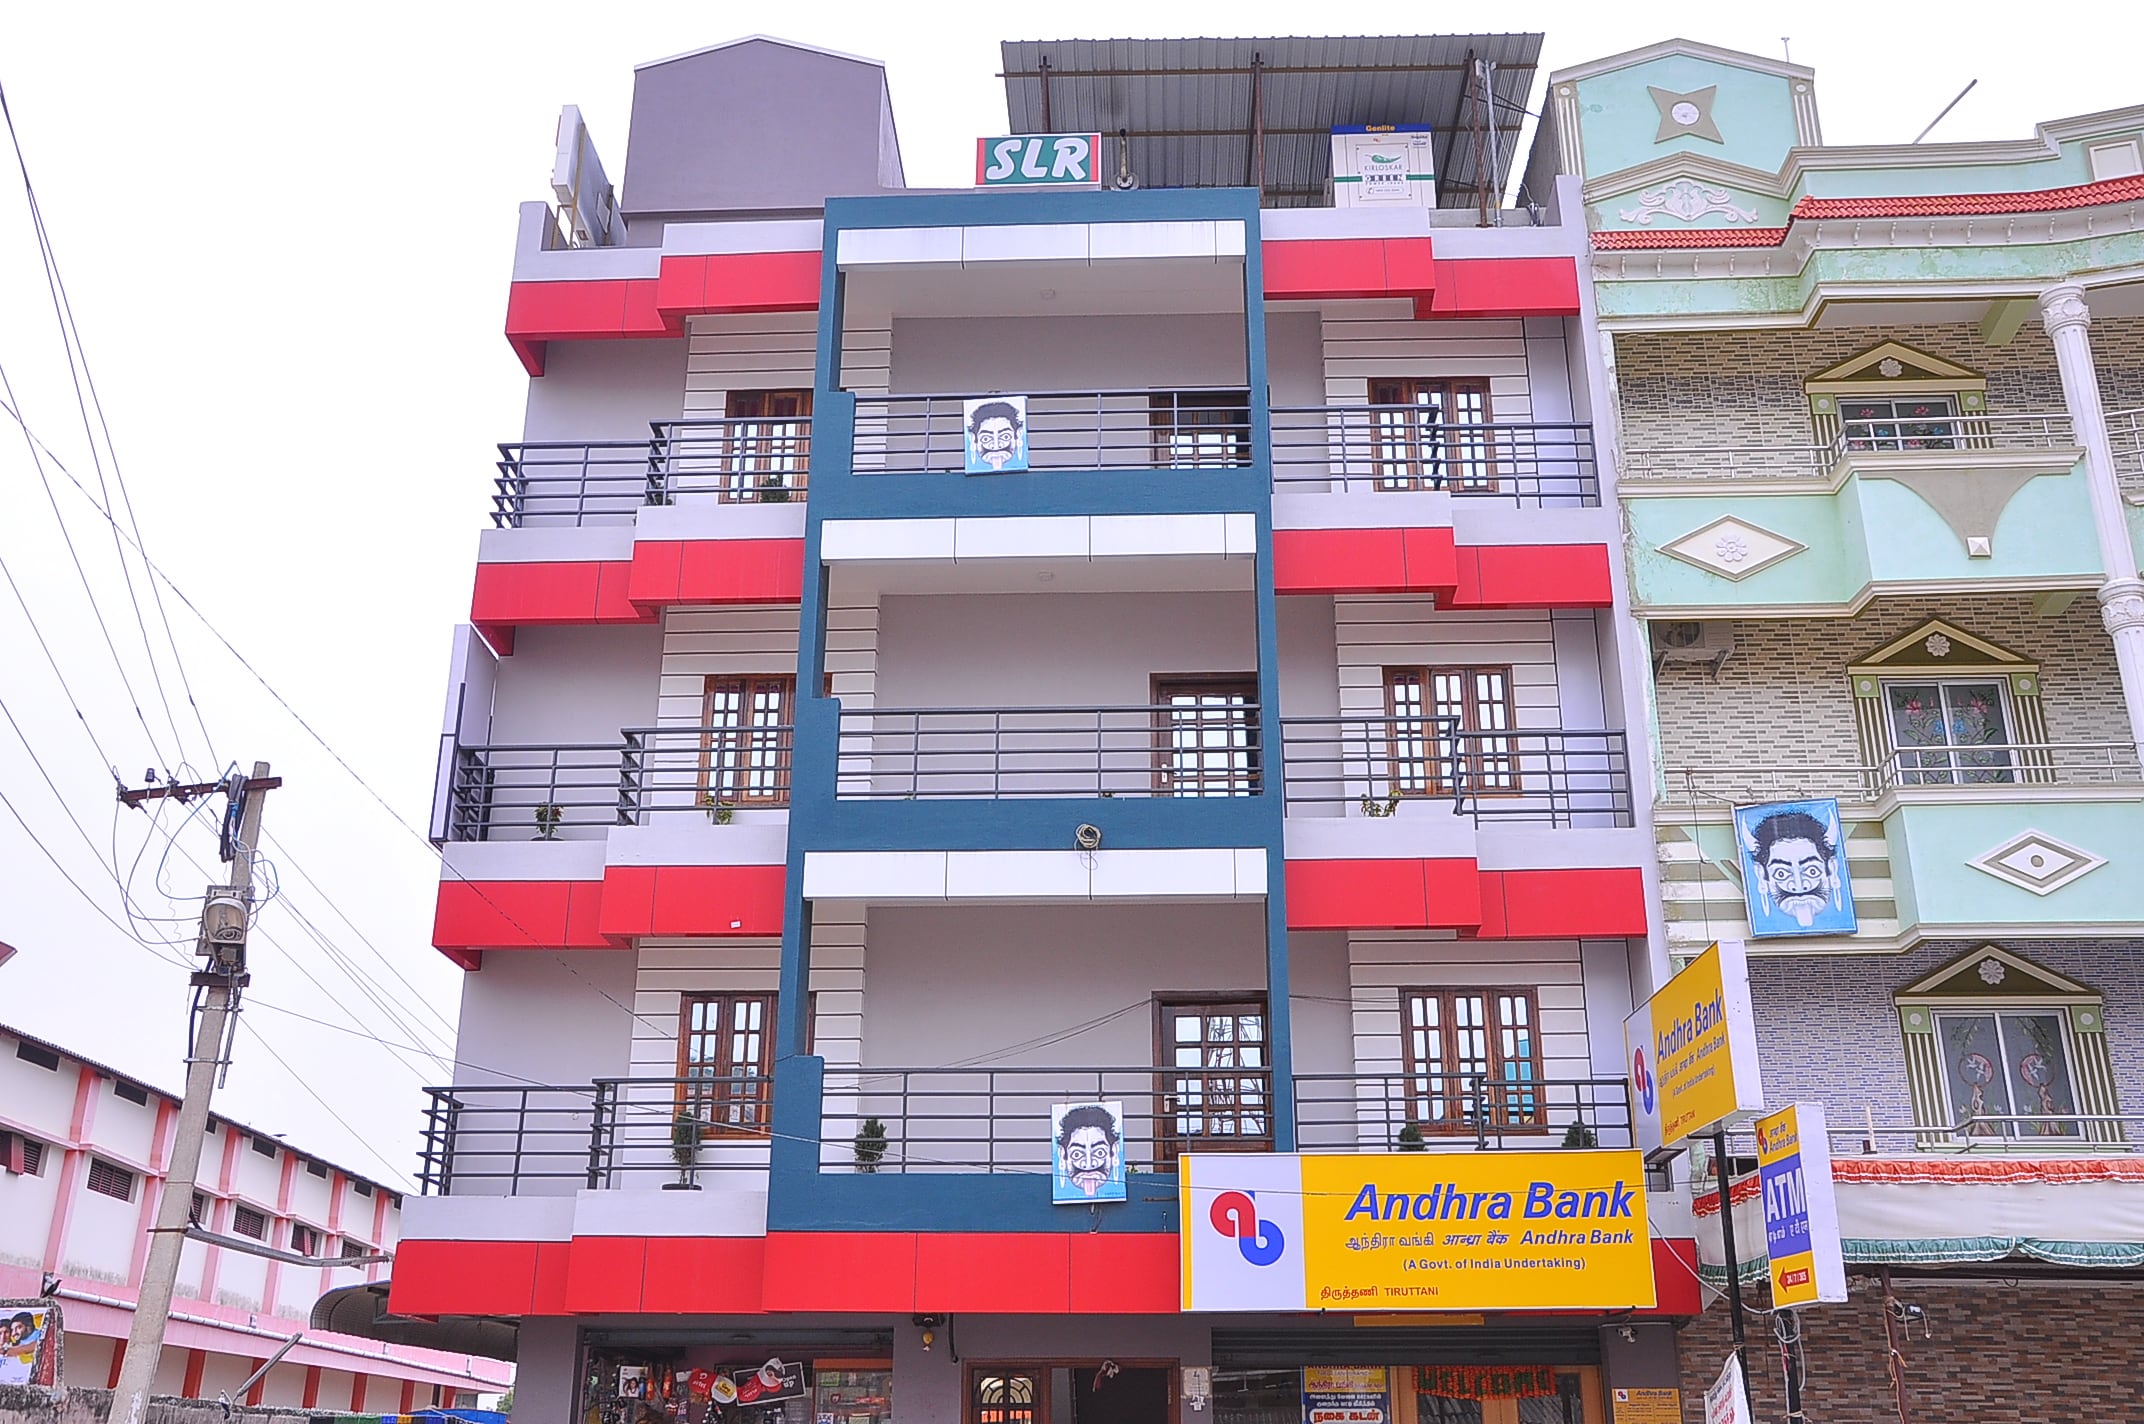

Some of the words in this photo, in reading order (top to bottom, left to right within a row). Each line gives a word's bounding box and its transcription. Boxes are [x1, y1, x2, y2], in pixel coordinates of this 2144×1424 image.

[985, 137, 1089, 180] SLR
[1657, 1017, 1693, 1064] Andhra
[1695, 988, 1722, 1037] Bank
[1696, 1043, 1713, 1061] Andhra
[1714, 1032, 1726, 1051] Bank
[1770, 1138, 1786, 1152] Andhra
[1786, 1132, 1798, 1147] Bank
[1344, 1183, 1512, 1220] Andhra
[1523, 1181, 1635, 1218] Bank
[1767, 1167, 1806, 1223] ATM
[1345, 1232, 1395, 1250] ஆந்திரா
[1399, 1231, 1435, 1247] வங்கி
[1486, 1230, 1510, 1245] बैंक
[1520, 1229, 1586, 1245] Andhra
[1590, 1229, 1634, 1244] Bank
[1403, 1259, 1417, 1272] (A
[1419, 1259, 1453, 1269] Govt.
[1455, 1259, 1468, 1269] of
[1470, 1258, 1501, 1269] India
[1504, 1257, 1586, 1270] Undertaking)
[1320, 1286, 1378, 1300] திருத்தணி
[1384, 1287, 1438, 1296] TIRUTTANI
[692, 1381, 707, 1389] airtel
[1314, 1412, 1344, 1424] நகை
[1349, 1409, 1380, 1420] கடன்
